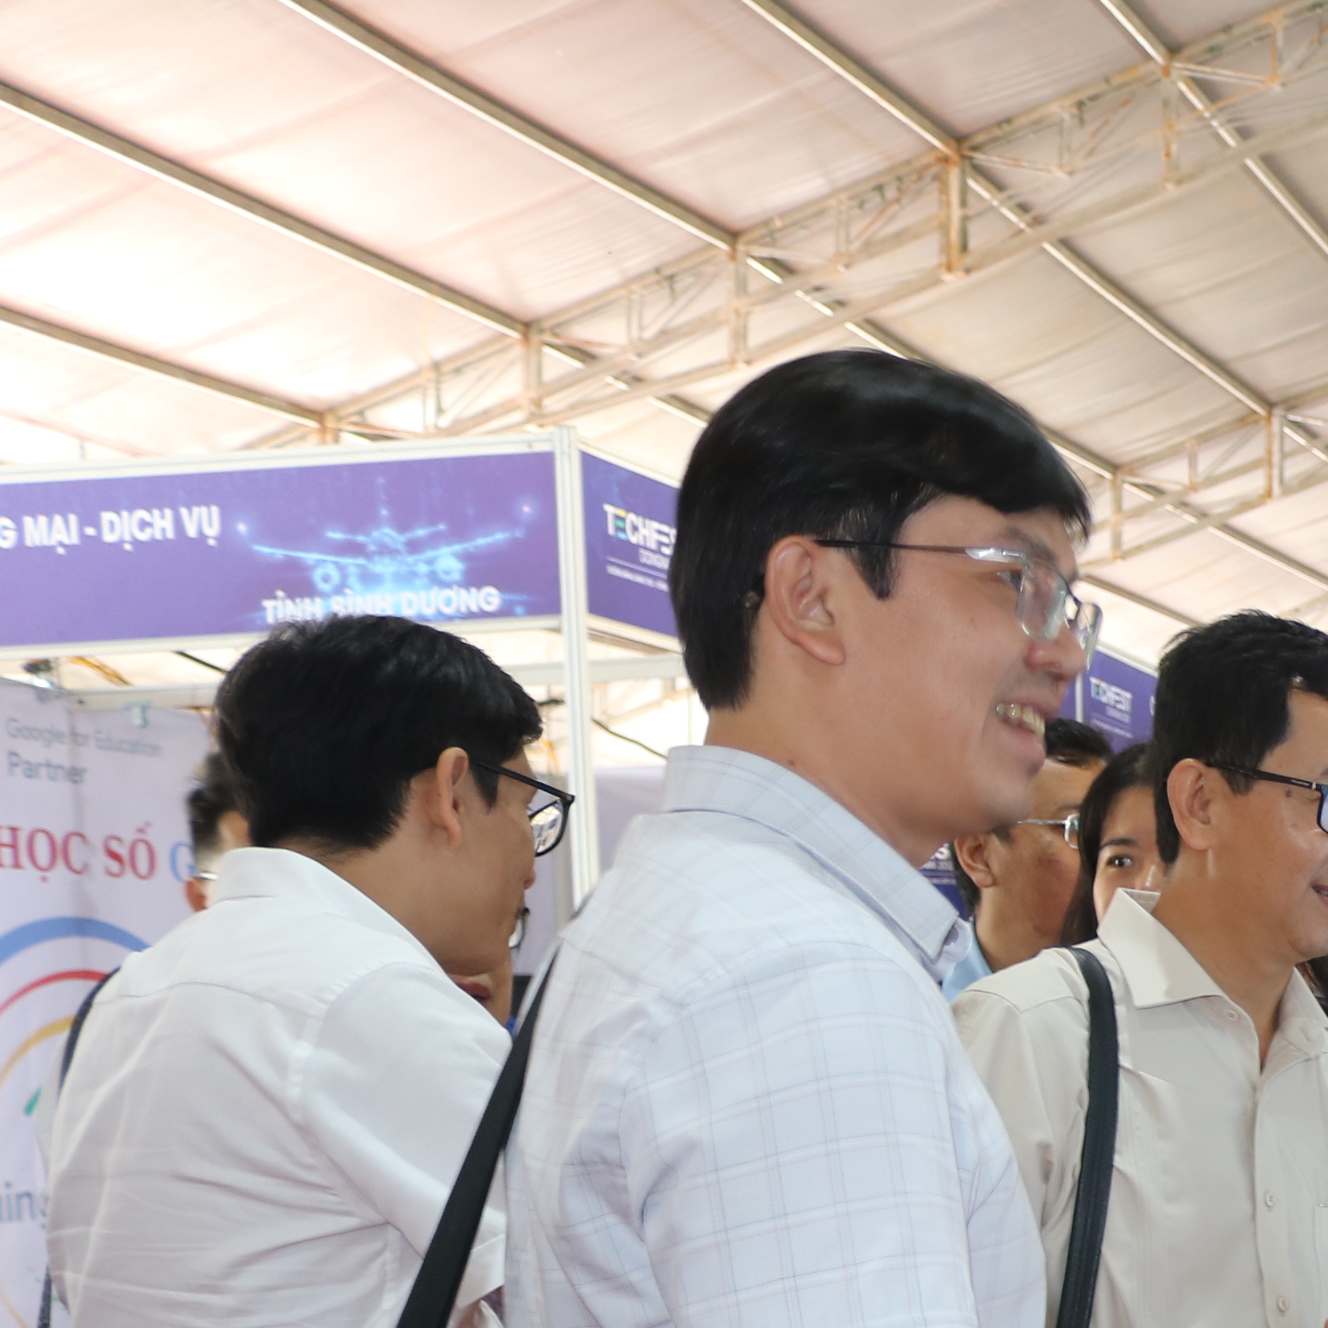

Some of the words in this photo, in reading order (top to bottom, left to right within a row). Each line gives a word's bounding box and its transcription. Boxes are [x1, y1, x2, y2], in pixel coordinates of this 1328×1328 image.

[22, 513, 80, 556] MẠI
[100, 507, 176, 552] DỊCH
[179, 504, 222, 547] VỤ
[7, 750, 88, 784] Partner
[103, 820, 157, 880] SỐ
